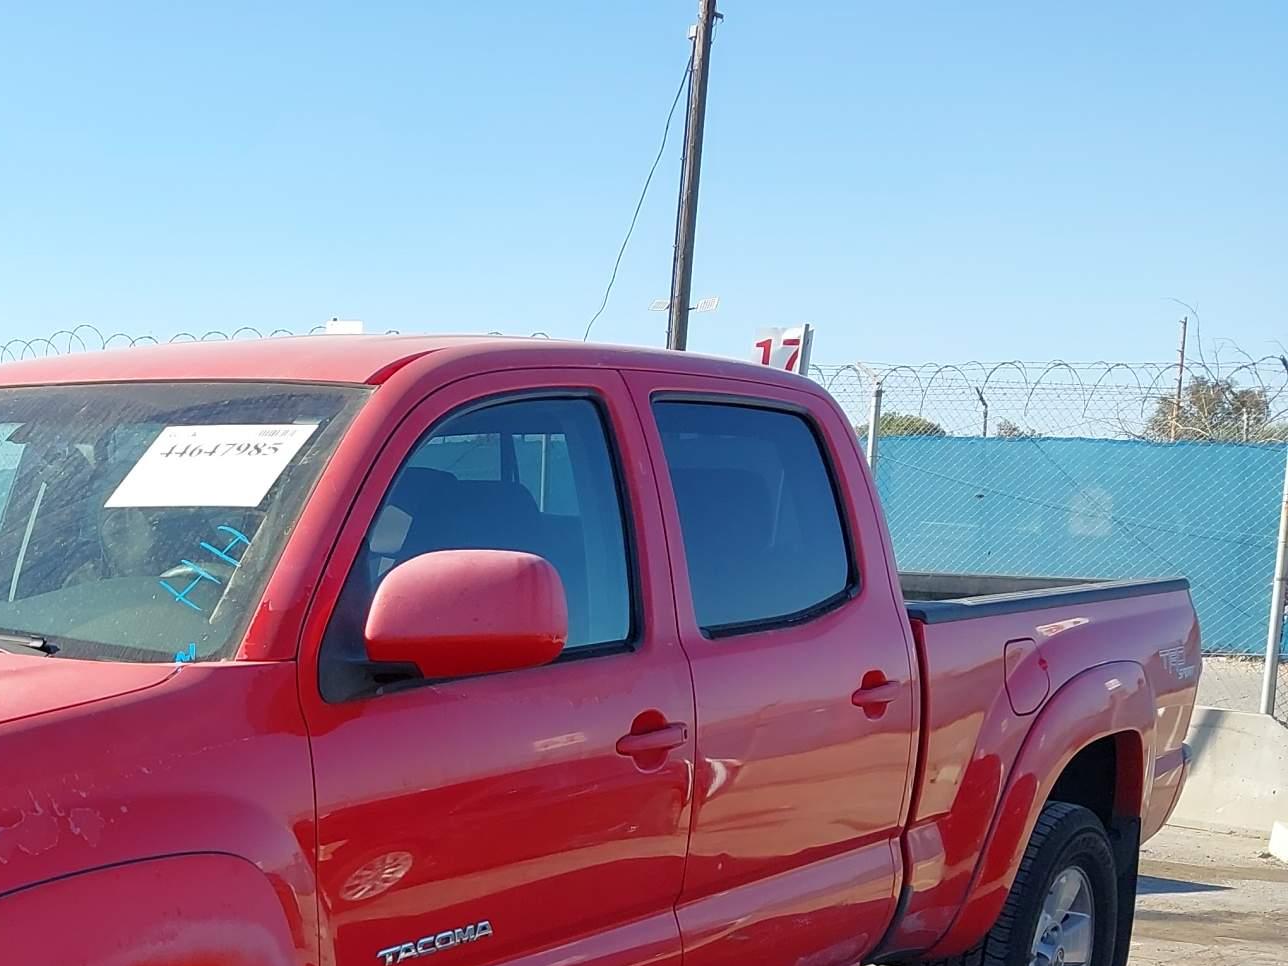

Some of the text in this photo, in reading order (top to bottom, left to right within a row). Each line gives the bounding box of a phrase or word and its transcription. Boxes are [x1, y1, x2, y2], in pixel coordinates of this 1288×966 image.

[755, 338, 800, 371] 17
[160, 442, 283, 459] 44647985
[376, 920, 494, 966] TACOMA
